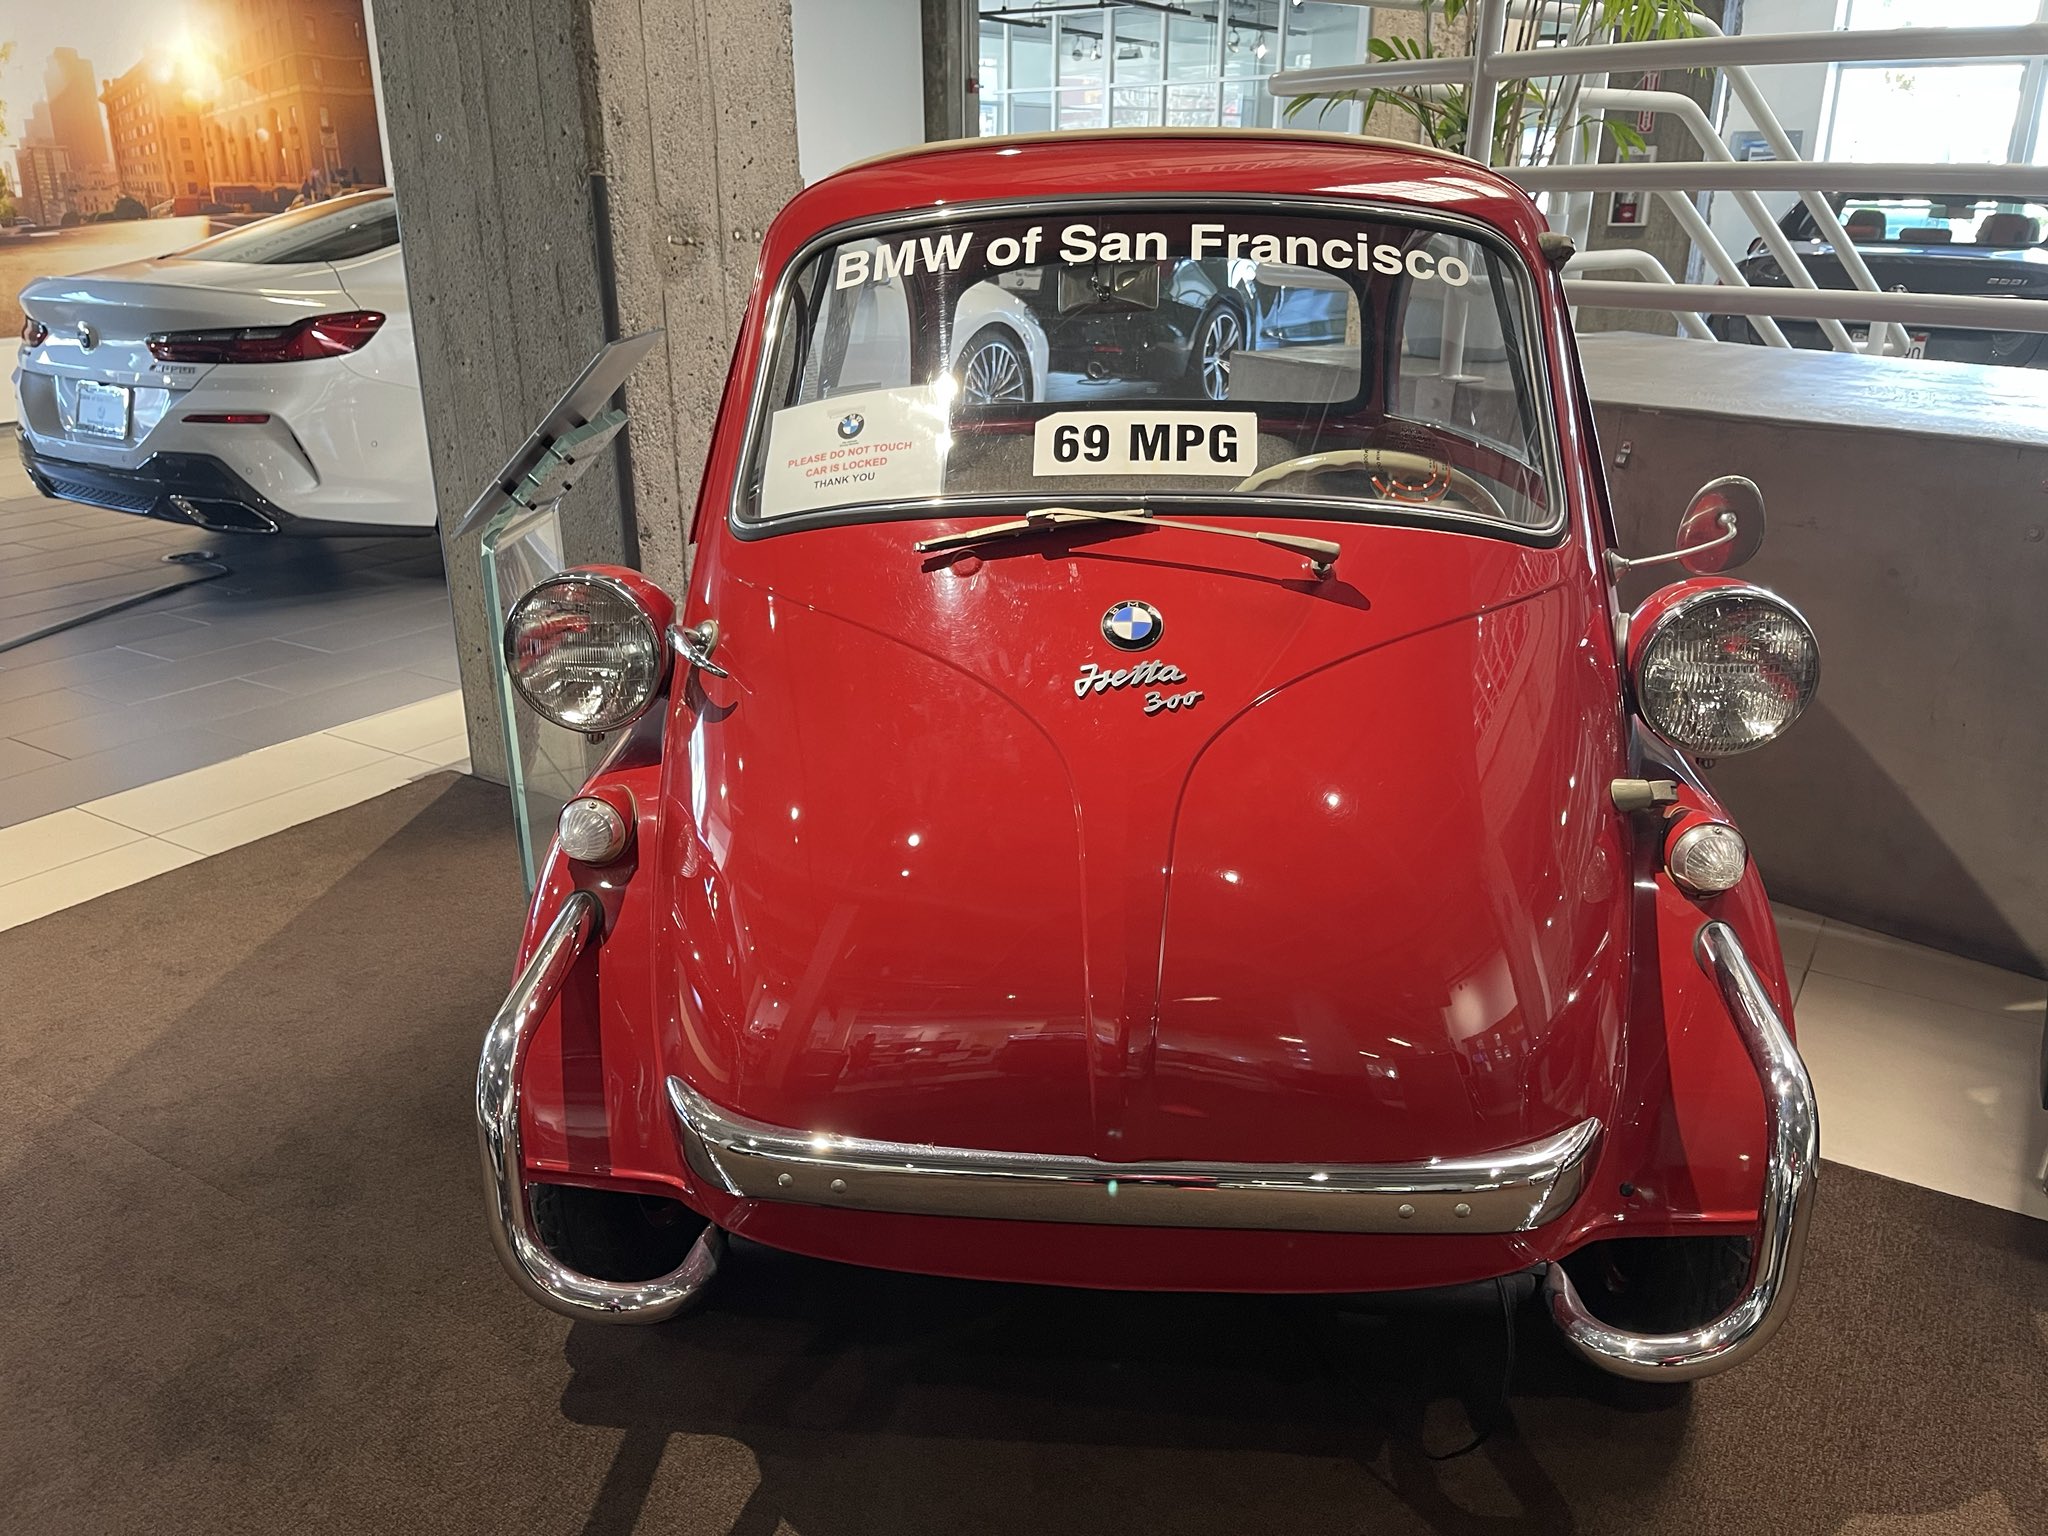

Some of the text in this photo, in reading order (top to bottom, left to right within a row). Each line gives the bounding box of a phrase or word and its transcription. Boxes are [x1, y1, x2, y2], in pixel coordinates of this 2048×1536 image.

[835, 223, 1469, 291] BMW of San Francisco
[788, 453, 827, 468] PLEASE
[830, 450, 845, 460] DO
[847, 445, 870, 457] NOT
[873, 441, 912, 453] TOUCH
[1053, 423, 1238, 463] 69 MPG
[805, 457, 888, 477] CAR IS LOCKED
[814, 472, 876, 488] THANK YOU
[1074, 660, 1187, 697] Isetta
[1143, 690, 1203, 712] 300
